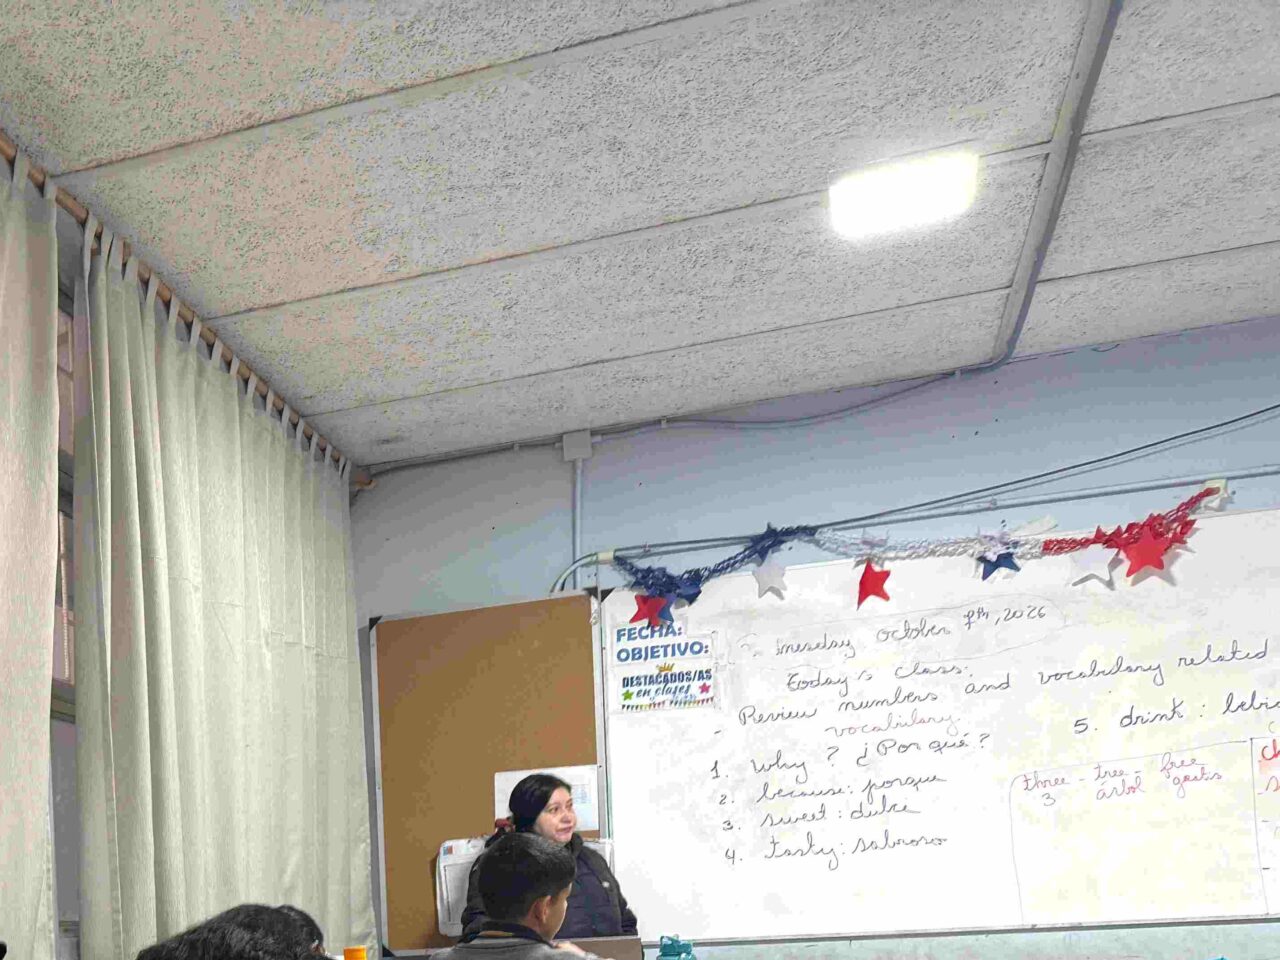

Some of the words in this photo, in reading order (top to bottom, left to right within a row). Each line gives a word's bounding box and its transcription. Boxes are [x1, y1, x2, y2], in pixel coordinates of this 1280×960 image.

[616, 623, 683, 643] FECHA:
[616, 641, 709, 663] OBJETIVO:
[622, 668, 713, 689] DESTACADOS/AS
[739, 705, 817, 726] Review
[838, 686, 938, 712] numbers
[965, 672, 1010, 694] and
[1178, 639, 1268, 667] related
[636, 688, 651, 698] en
[1074, 718, 1098, 734] 5.
[711, 760, 728, 779] 1.
[1023, 771, 1070, 792] three
[1094, 762, 1129, 781] tree
[1160, 752, 1207, 779] free
[719, 794, 735, 805] 2.
[862, 775, 947, 804] porque
[1042, 793, 1056, 806] 3
[1096, 776, 1145, 801] árbol
[723, 820, 741, 830] 3.
[851, 795, 921, 820] dulce
[725, 850, 742, 864] 4.
[852, 829, 948, 855] sabroso
